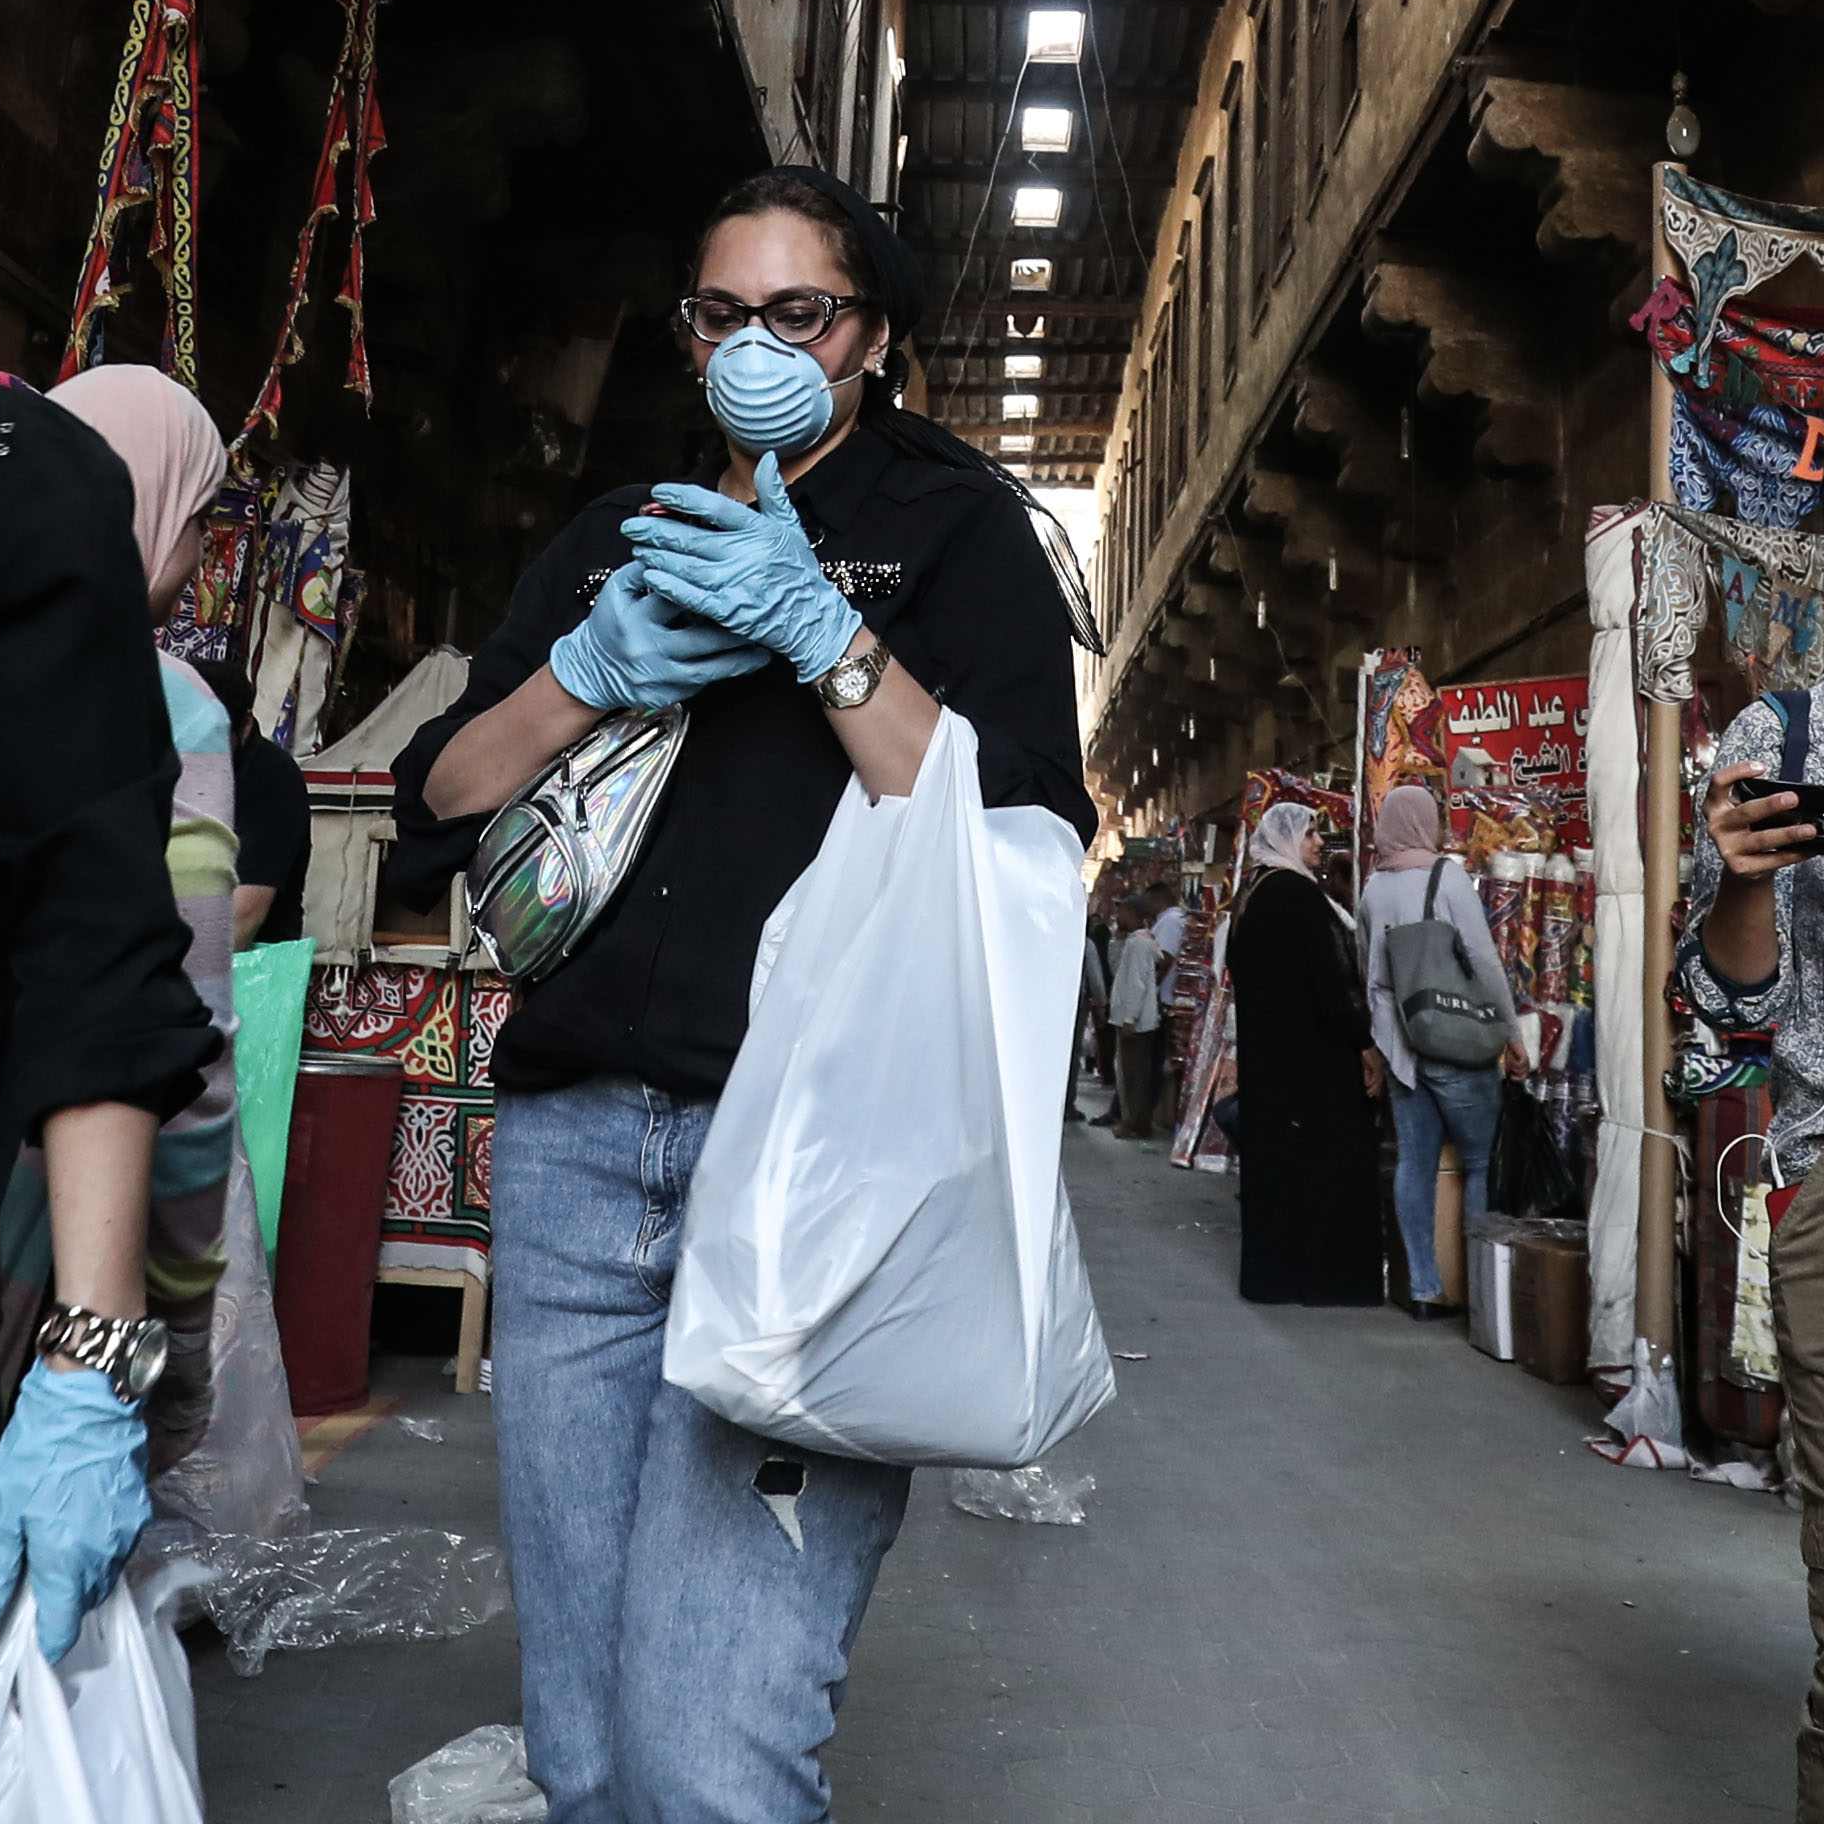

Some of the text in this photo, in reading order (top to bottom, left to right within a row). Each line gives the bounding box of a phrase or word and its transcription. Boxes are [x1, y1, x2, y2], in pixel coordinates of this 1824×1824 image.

[1448, 688, 1521, 745] اللطيف
[1528, 692, 1565, 740] عبد
[1510, 740, 1572, 787] الشيخ
